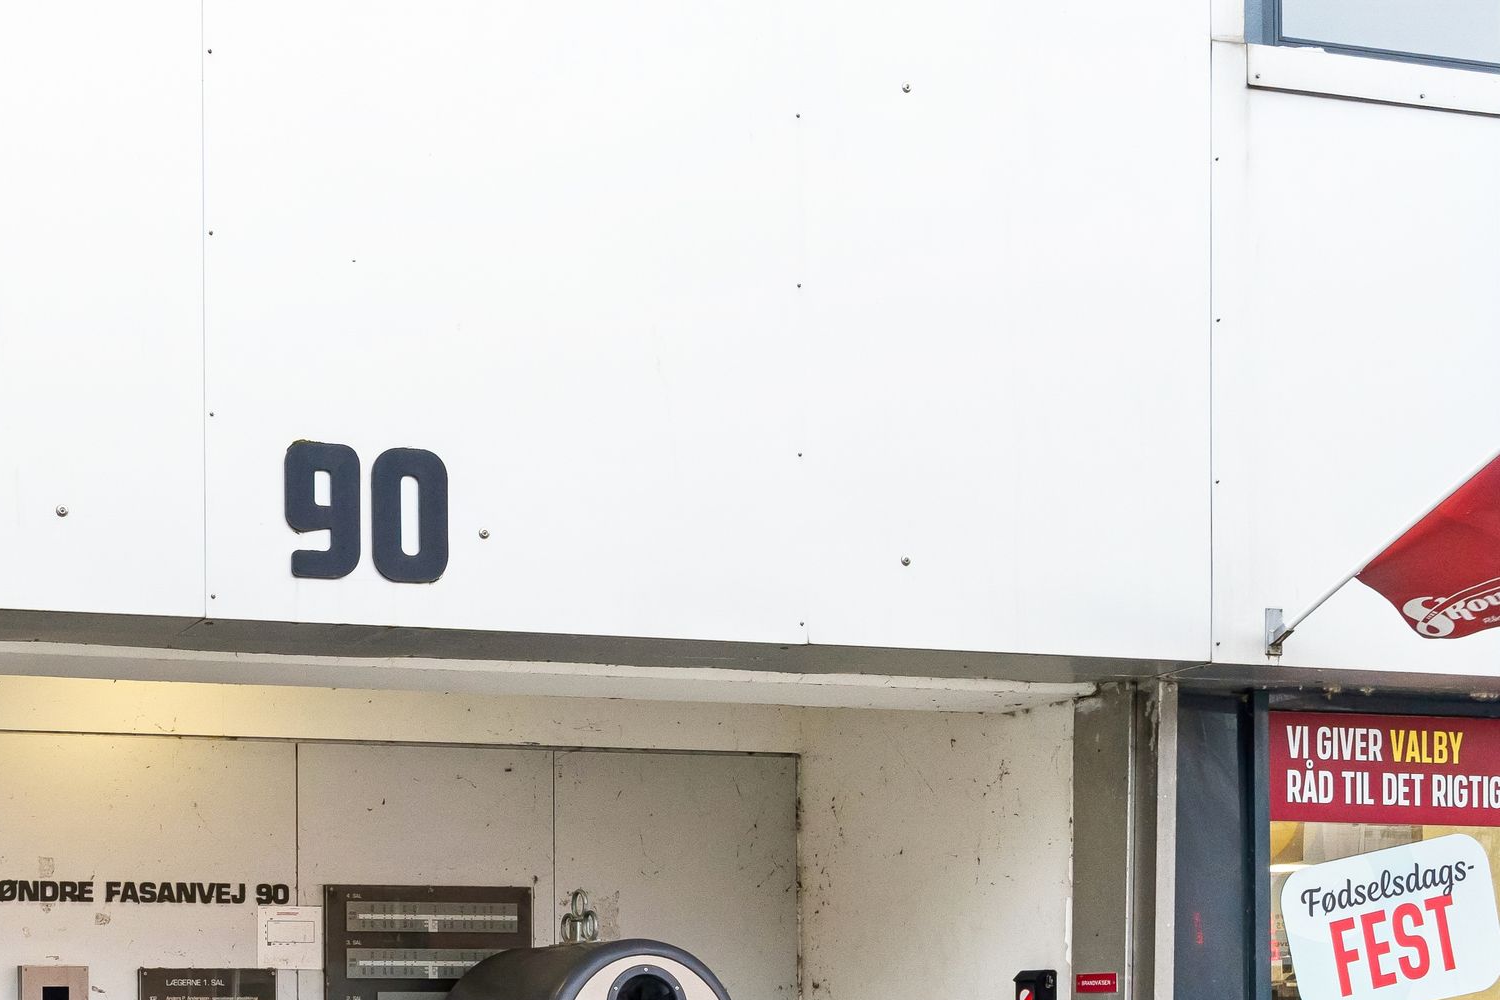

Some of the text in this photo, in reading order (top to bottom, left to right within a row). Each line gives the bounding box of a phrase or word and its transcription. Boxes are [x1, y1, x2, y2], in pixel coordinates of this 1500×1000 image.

[284, 439, 449, 584] 90
[1286, 725, 1464, 765] VI GIVER VALBY
[1286, 759, 1500, 810] RÅD TIL DET RIGTIG
[105, 881, 246, 904] FASANVEJ
[256, 884, 290, 905] 90
[1300, 861, 1475, 917] Fødselsdags-
[1329, 894, 1457, 997] FEST
[165, 979, 225, 987] LÆGERNE 1. SAL
